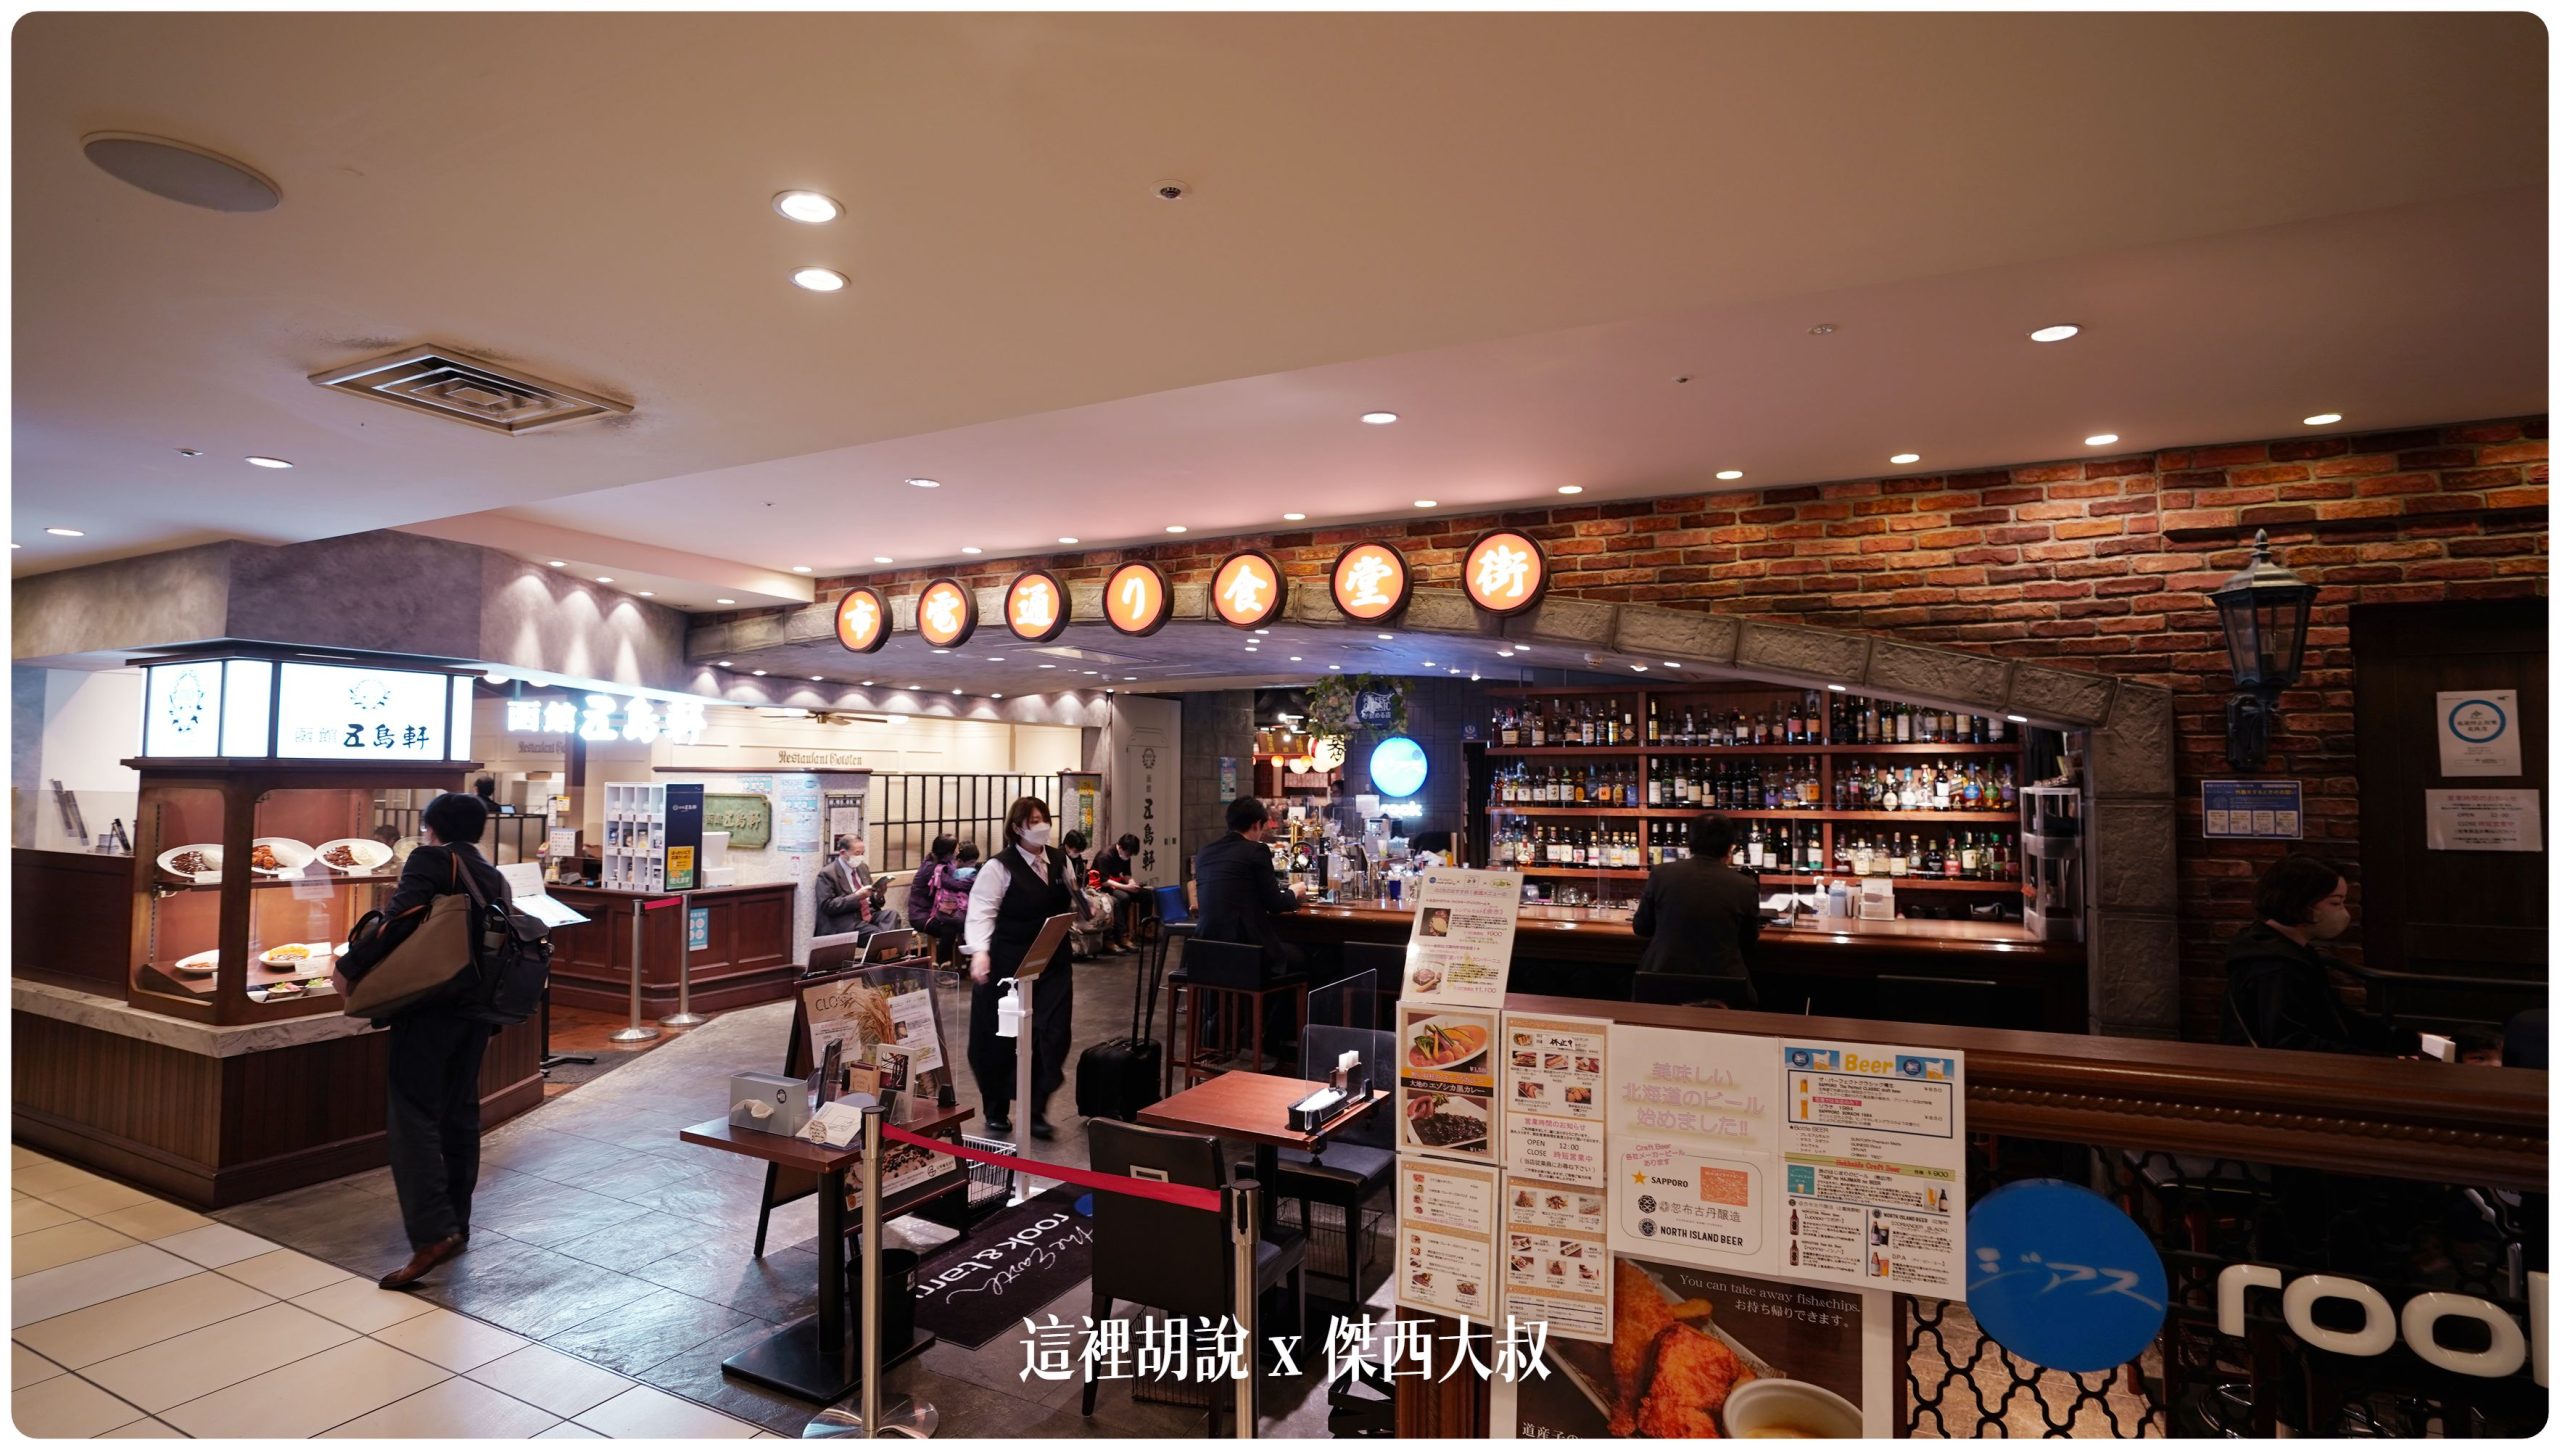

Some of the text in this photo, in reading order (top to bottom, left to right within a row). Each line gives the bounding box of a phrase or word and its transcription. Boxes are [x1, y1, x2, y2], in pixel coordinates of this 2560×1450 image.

[844, 545, 1529, 641] 市電通り食堂街
[1651, 1061, 1734, 1087] 美味しい
[1845, 1053, 1895, 1075] Beer
[1621, 1081, 1766, 1116] 北海道のビール
[1524, 1117, 1587, 1132] 営業時間のお知らせ
[1526, 1138, 1546, 1147] OPEN
[1635, 1144, 1655, 1152] Craft
[1526, 1148, 1593, 1163] CLOSE 時短営業中
[1651, 1176, 1689, 1188] SAPPORO
[1660, 1225, 1743, 1247] NORTH ISLAND BEER
[1679, 1274, 1703, 1288] You
[1706, 1280, 1727, 1292] can
[1731, 1283, 1756, 1296] take
[1759, 1288, 1793, 1303] away
[1735, 1299, 1849, 1328] お持ち帰りできます。
